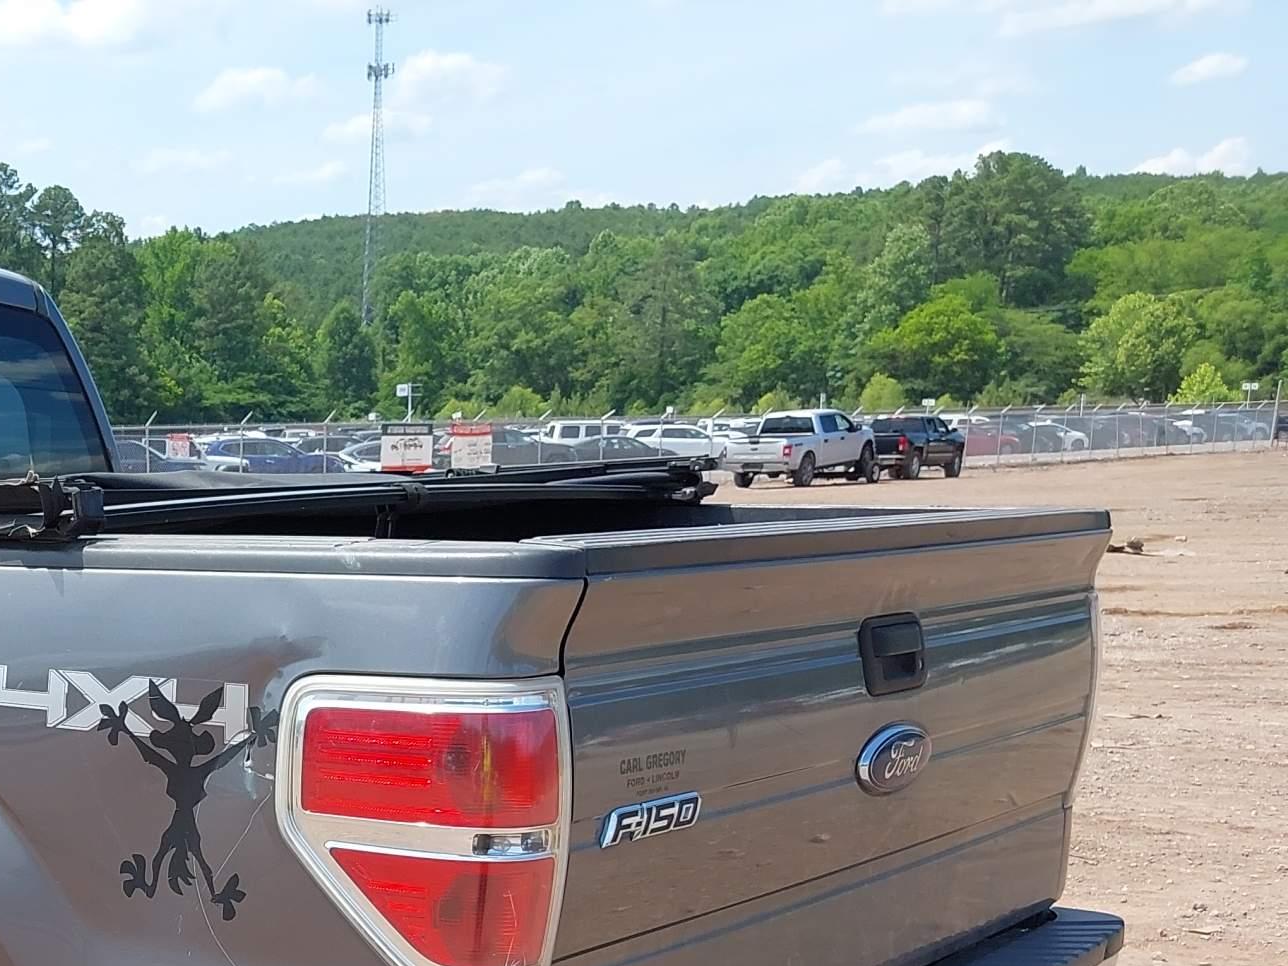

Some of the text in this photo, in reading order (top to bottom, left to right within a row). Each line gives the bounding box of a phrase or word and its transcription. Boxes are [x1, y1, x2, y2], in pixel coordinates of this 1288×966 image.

[619, 749, 687, 775] CARL GREGORY
[626, 770, 681, 788] FORD LINCOLN
[601, 791, 702, 849] F-150
